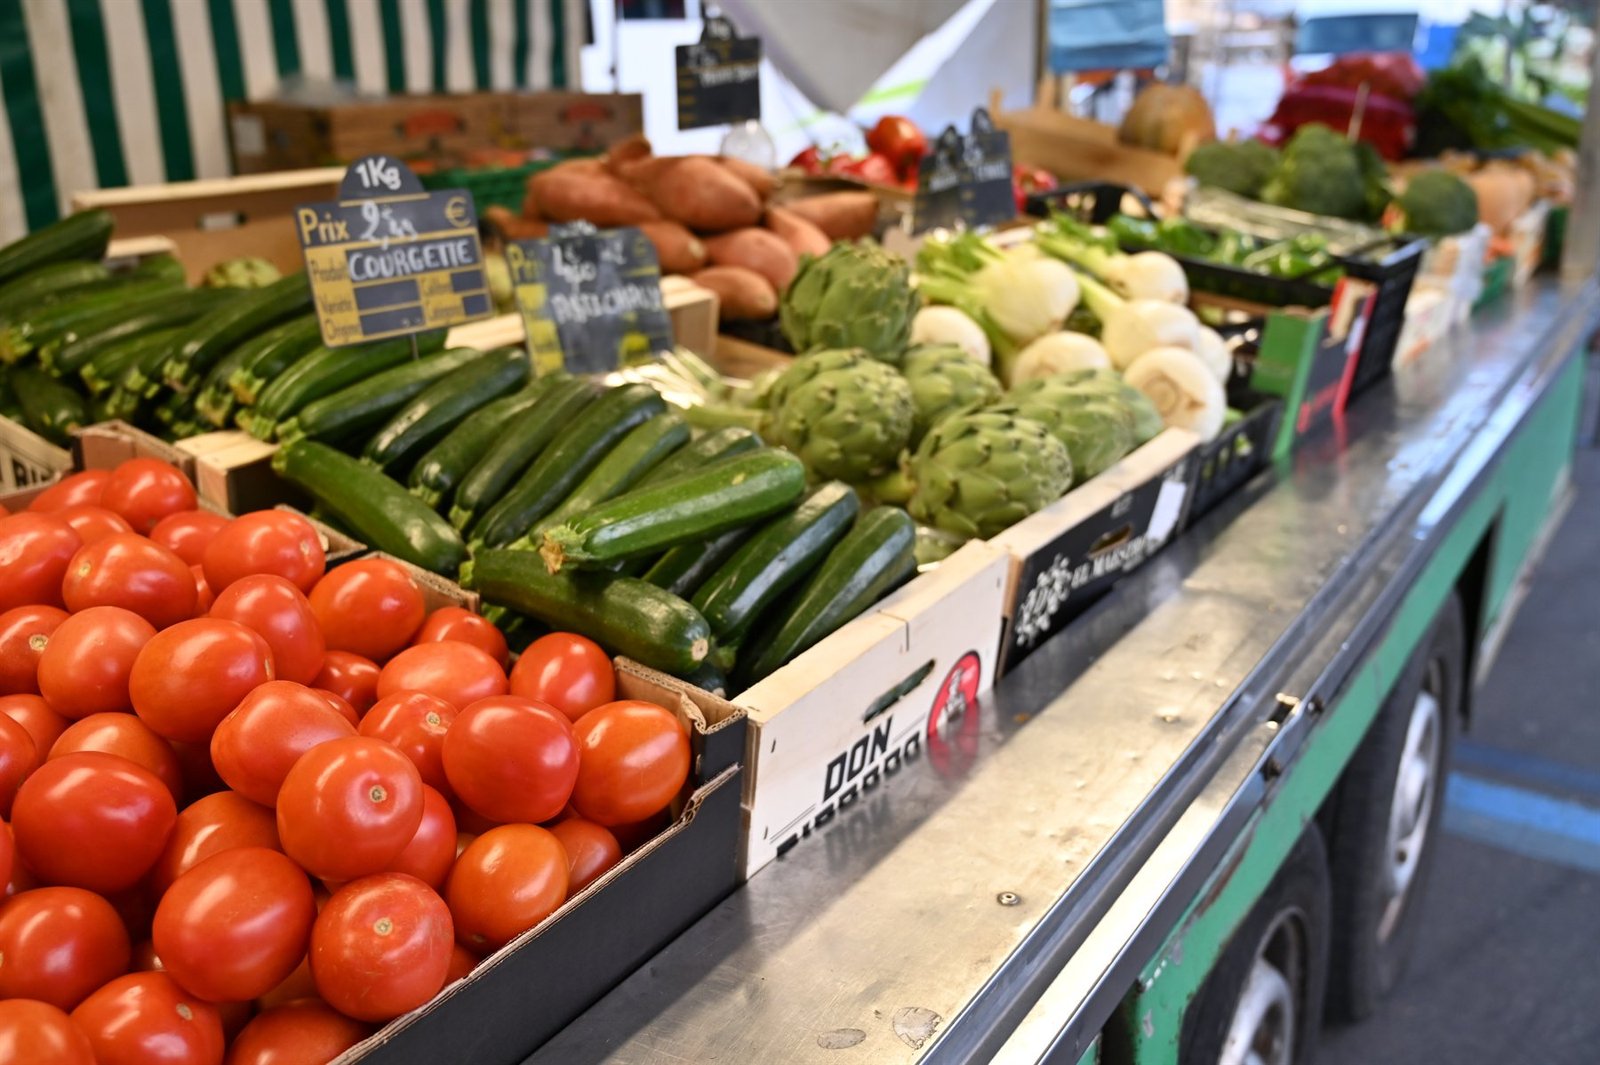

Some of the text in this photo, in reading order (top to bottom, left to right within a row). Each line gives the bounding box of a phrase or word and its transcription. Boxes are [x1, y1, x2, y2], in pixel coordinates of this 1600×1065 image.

[298, 207, 350, 245] Prix
[350, 238, 474, 282] COURGETTE
[822, 714, 893, 804] DON
